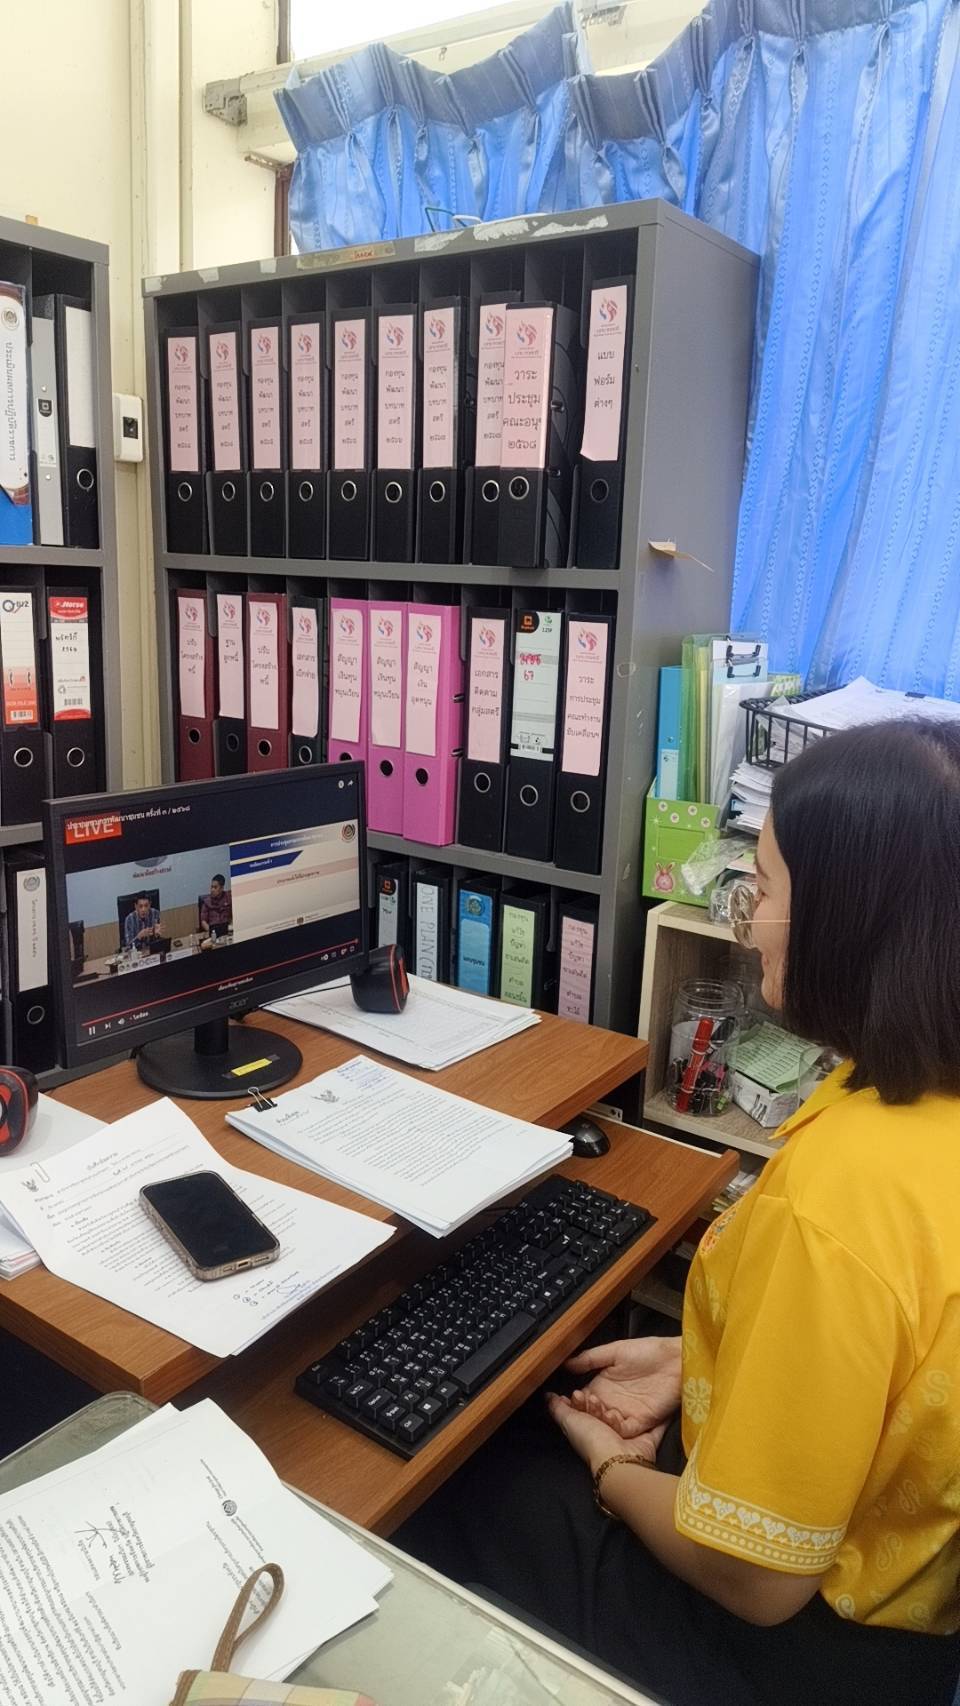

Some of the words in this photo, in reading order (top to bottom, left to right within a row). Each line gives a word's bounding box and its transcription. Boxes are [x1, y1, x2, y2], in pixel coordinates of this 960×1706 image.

[598, 351, 615, 360] แบบ
[514, 370, 537, 380] วาระ
[594, 373, 615, 385] ฟอร์ม
[508, 391, 541, 408] ประชุม
[594, 397, 613, 408] ต่างๆ
[74, 823, 115, 839] LIVE
